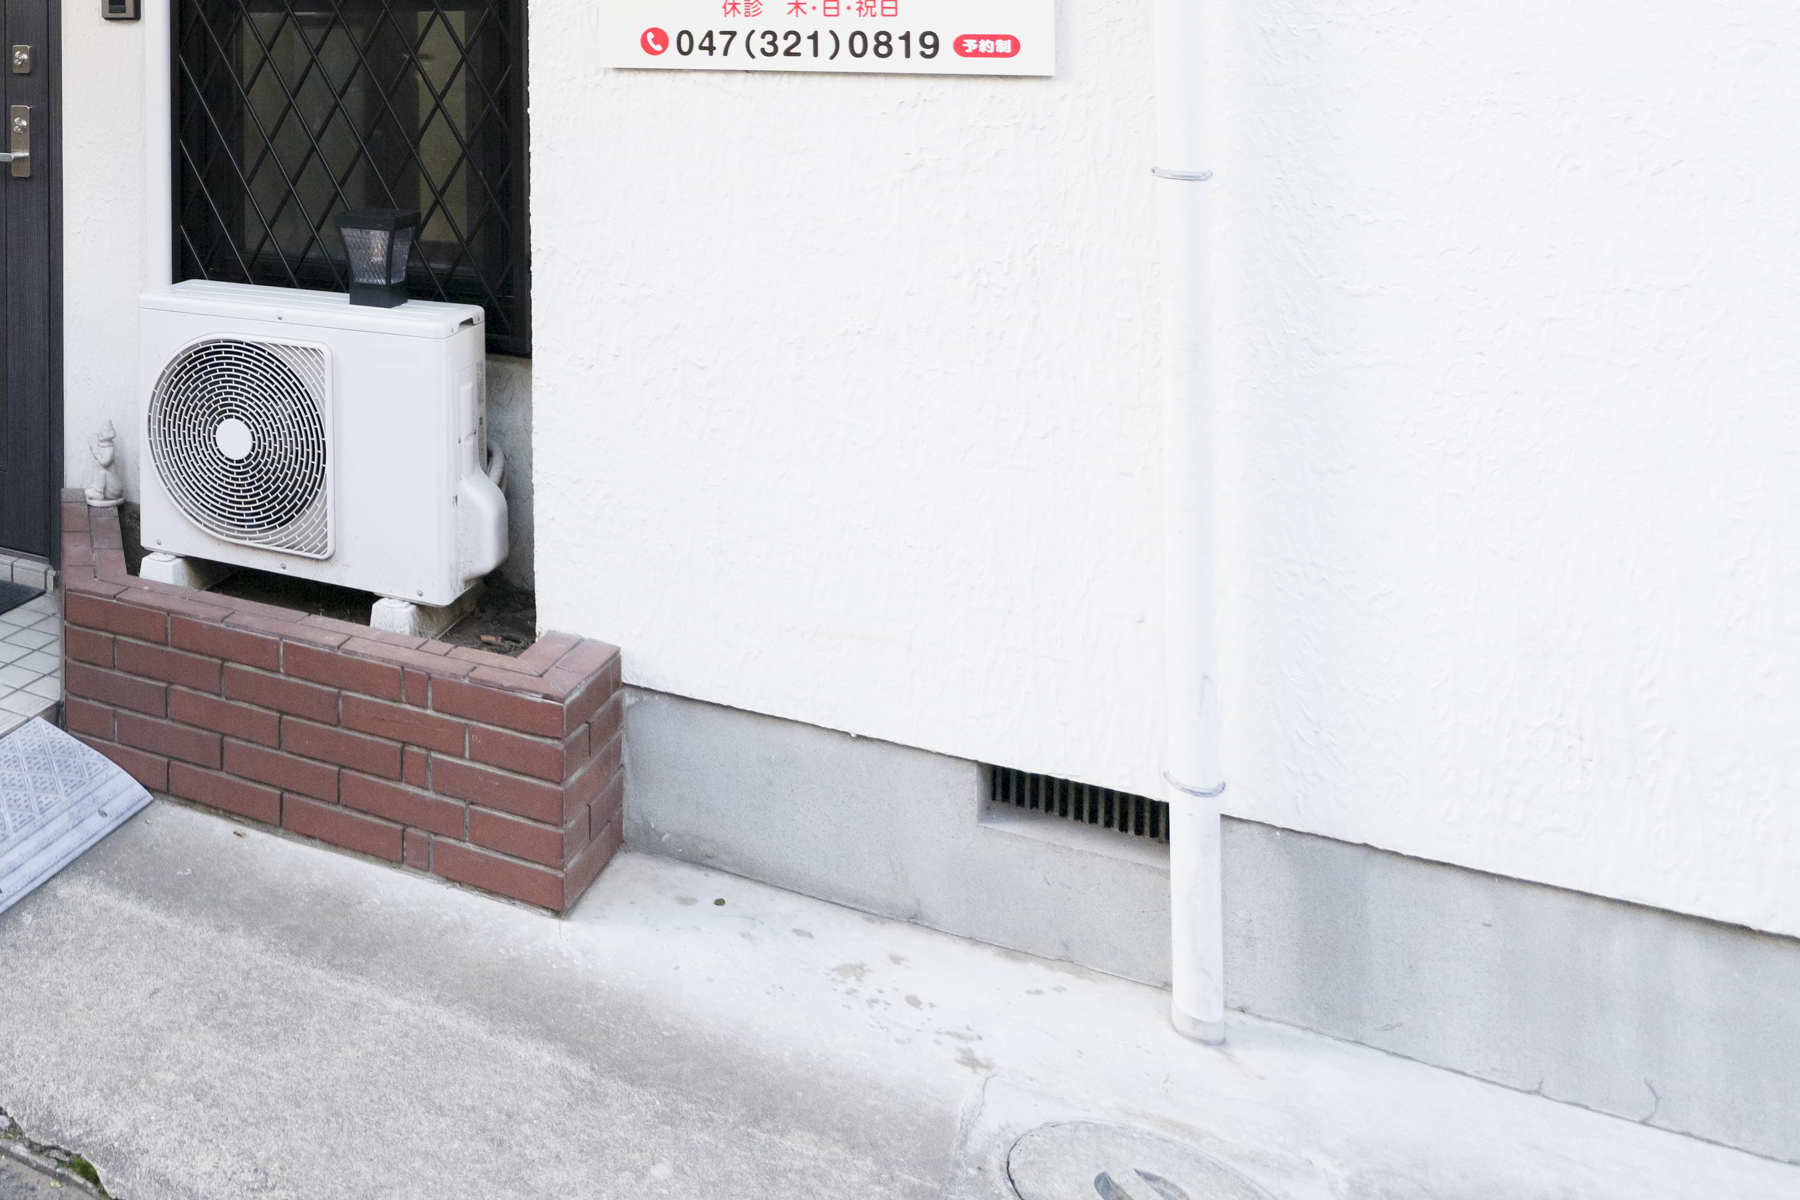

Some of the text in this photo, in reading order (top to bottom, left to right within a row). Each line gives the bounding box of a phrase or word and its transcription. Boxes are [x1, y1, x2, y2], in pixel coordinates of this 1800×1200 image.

[722, 0, 899, 18] 休診 木・日・祝日
[676, 30, 940, 61] 047(321)0819
[962, 39, 1012, 55] 予約制
